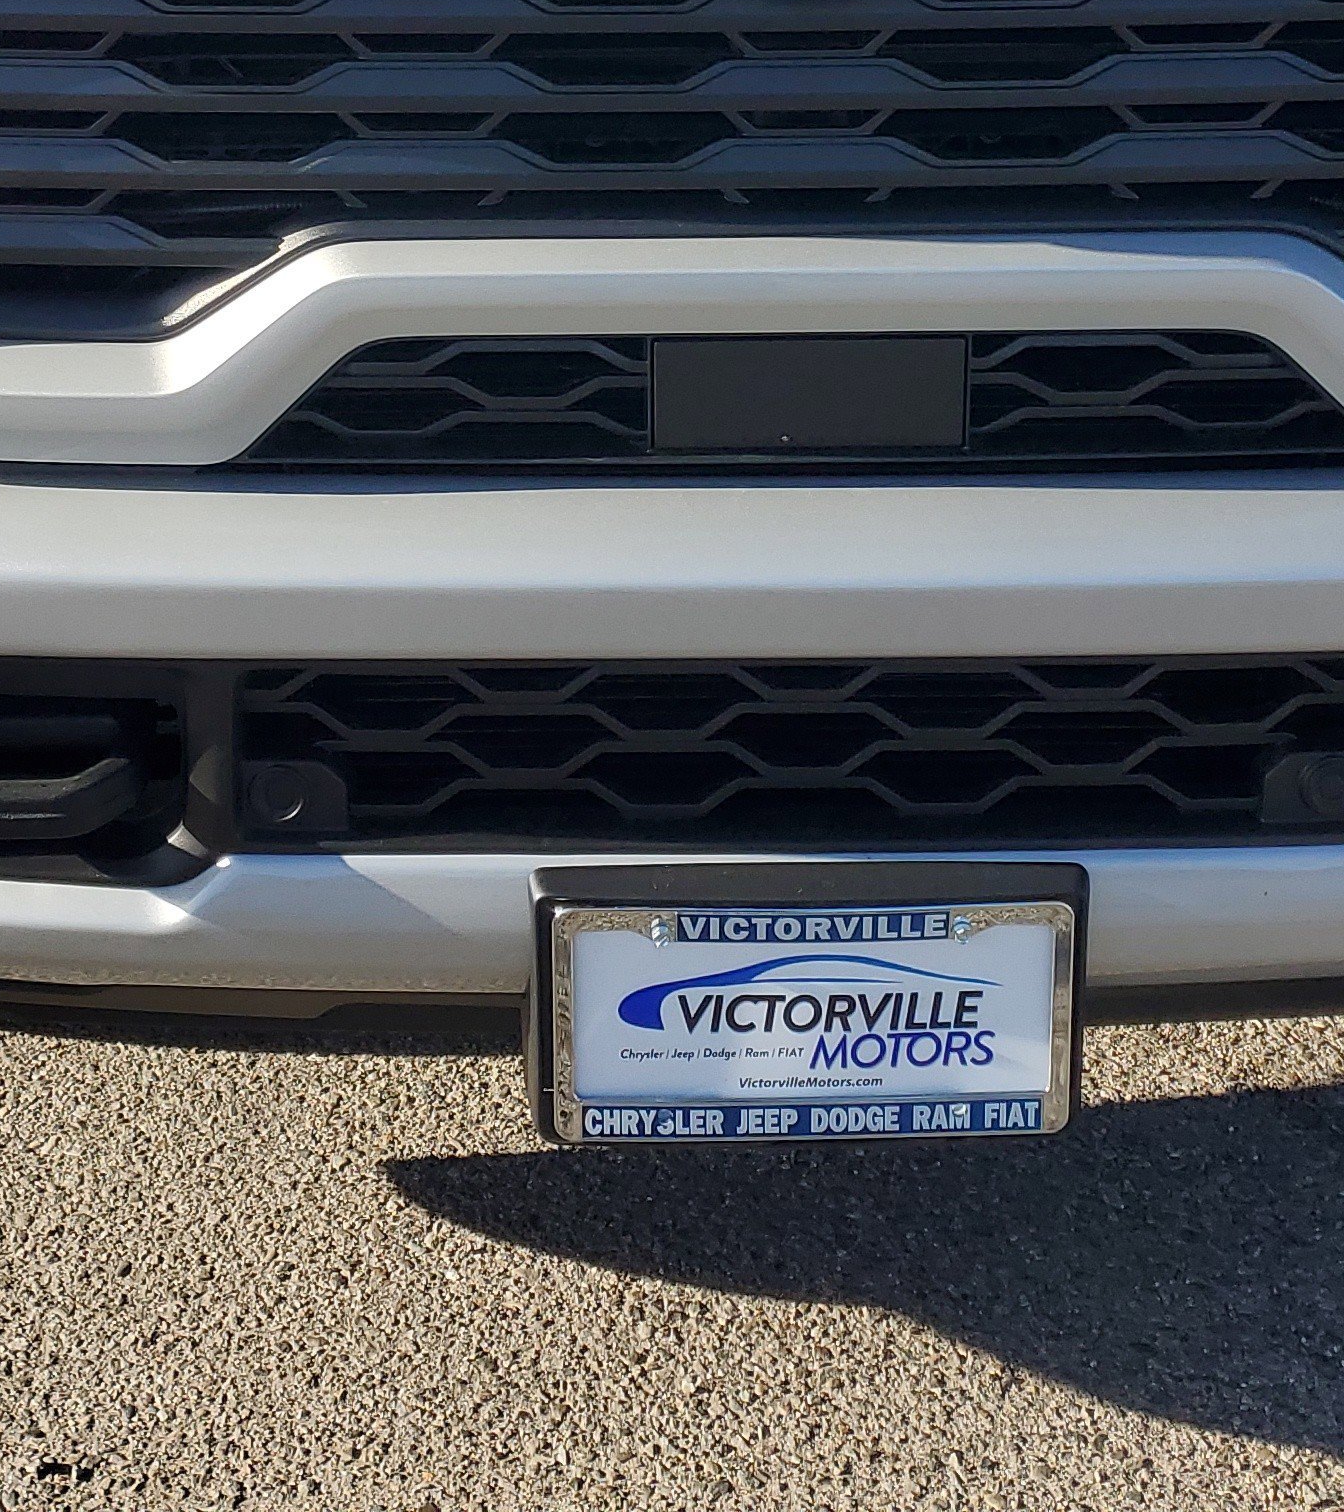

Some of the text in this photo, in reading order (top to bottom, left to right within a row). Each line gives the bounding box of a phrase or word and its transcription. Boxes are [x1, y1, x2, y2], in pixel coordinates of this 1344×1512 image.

[680, 914, 947, 941] VICTORVILLE
[678, 990, 984, 1034] VICTORVILLE
[620, 1048, 665, 1063] Chrysler
[671, 1049, 695, 1062] Jeep
[703, 1047, 737, 1061] Dodge
[745, 1047, 769, 1058] Ram
[777, 1047, 805, 1058] FIAT
[809, 1030, 996, 1070] MOTORS
[739, 1076, 883, 1088] VictorvilleMotors.com
[584, 1100, 1039, 1135] CHRYSLER JEEP DODGE RAM FIAT
